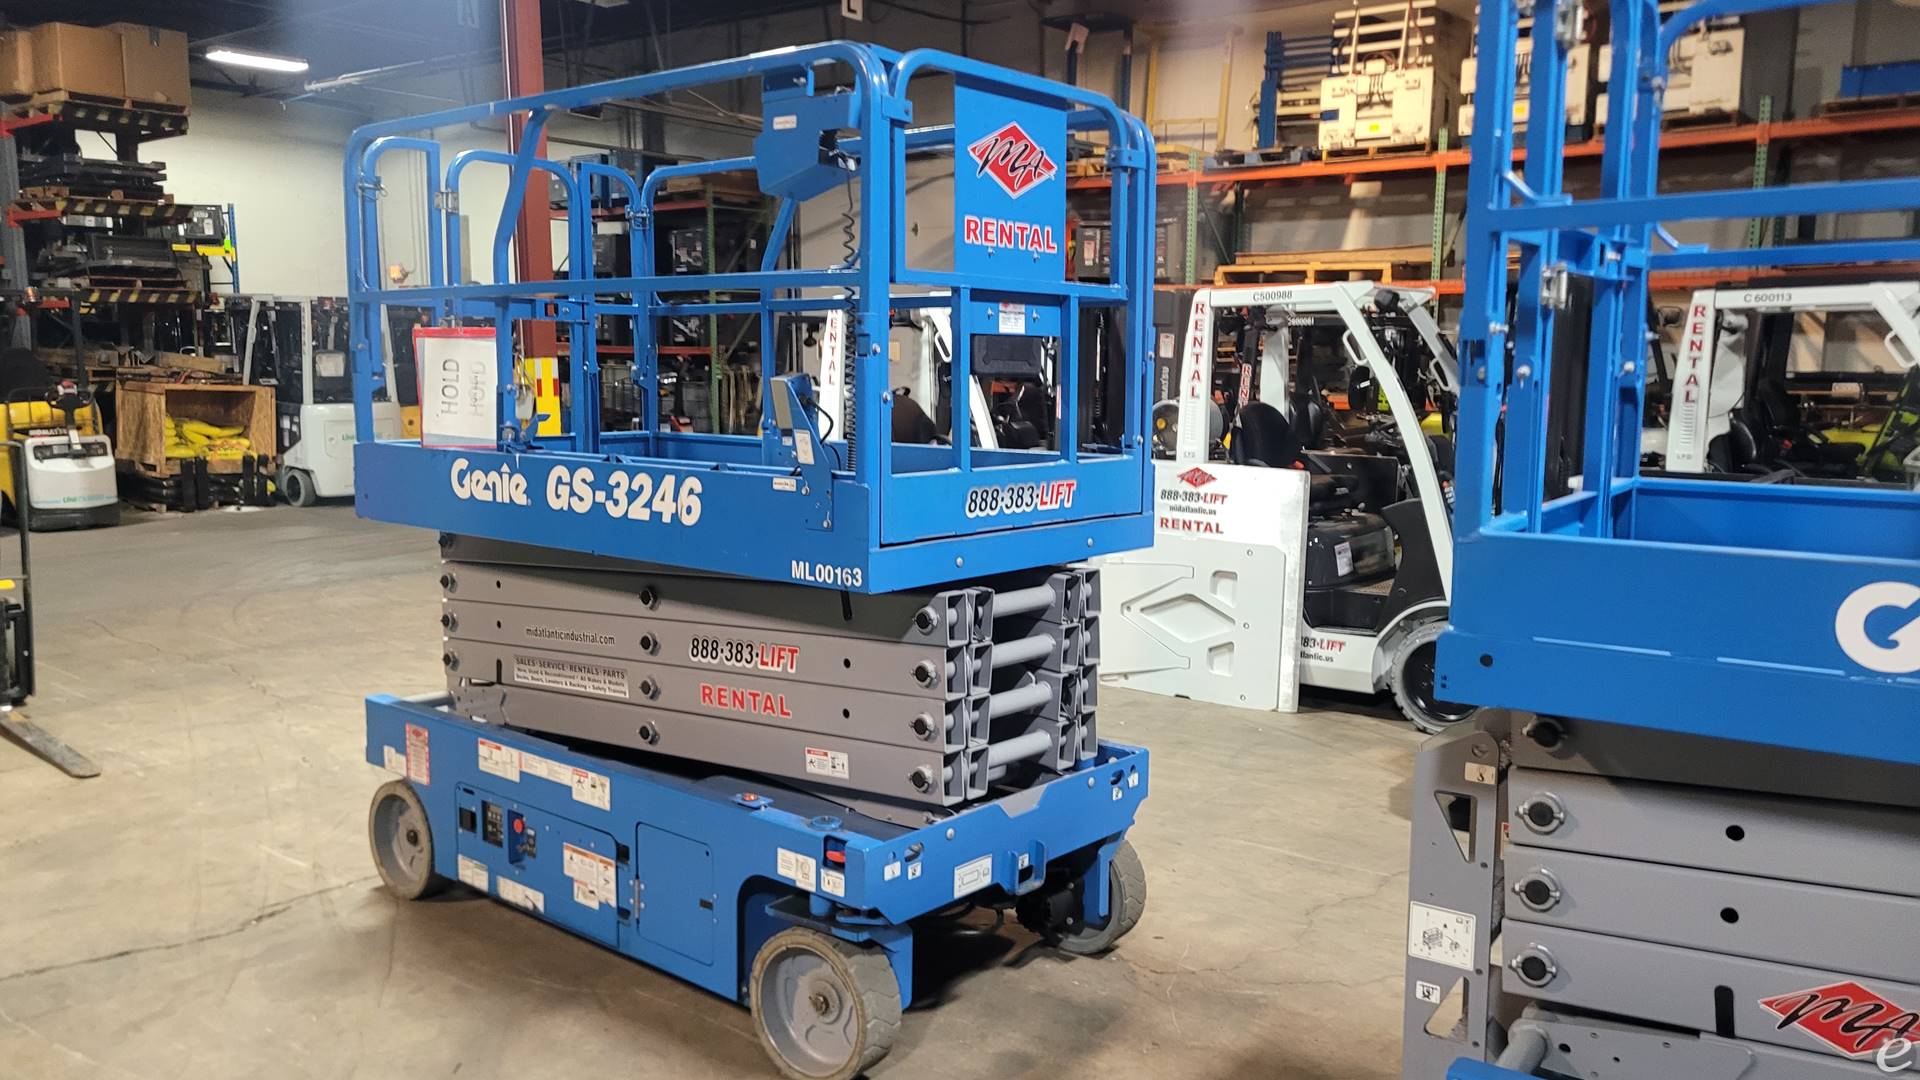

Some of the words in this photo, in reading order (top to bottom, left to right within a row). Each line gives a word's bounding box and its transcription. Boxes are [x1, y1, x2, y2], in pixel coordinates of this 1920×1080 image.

[965, 218, 1057, 253] RENTAL
[1253, 290, 1293, 301] C500988
[1754, 292, 1792, 303] 600113
[1190, 302, 1206, 399] RENTAL
[1684, 304, 1707, 404] RENTAL
[441, 358, 460, 415] HOLD
[451, 458, 528, 506] Genie
[546, 464, 703, 528] GS-3246
[1160, 517, 1224, 535] RENTAL
[791, 560, 863, 588] ML00163
[526, 627, 615, 645] midatlanticindustrial.com
[515, 657, 536, 667] SALES
[538, 660, 566, 671] SERVICE
[569, 664, 600, 675] RENTALS
[602, 669, 625, 680] PARTS
[701, 683, 792, 717] RENTAL
